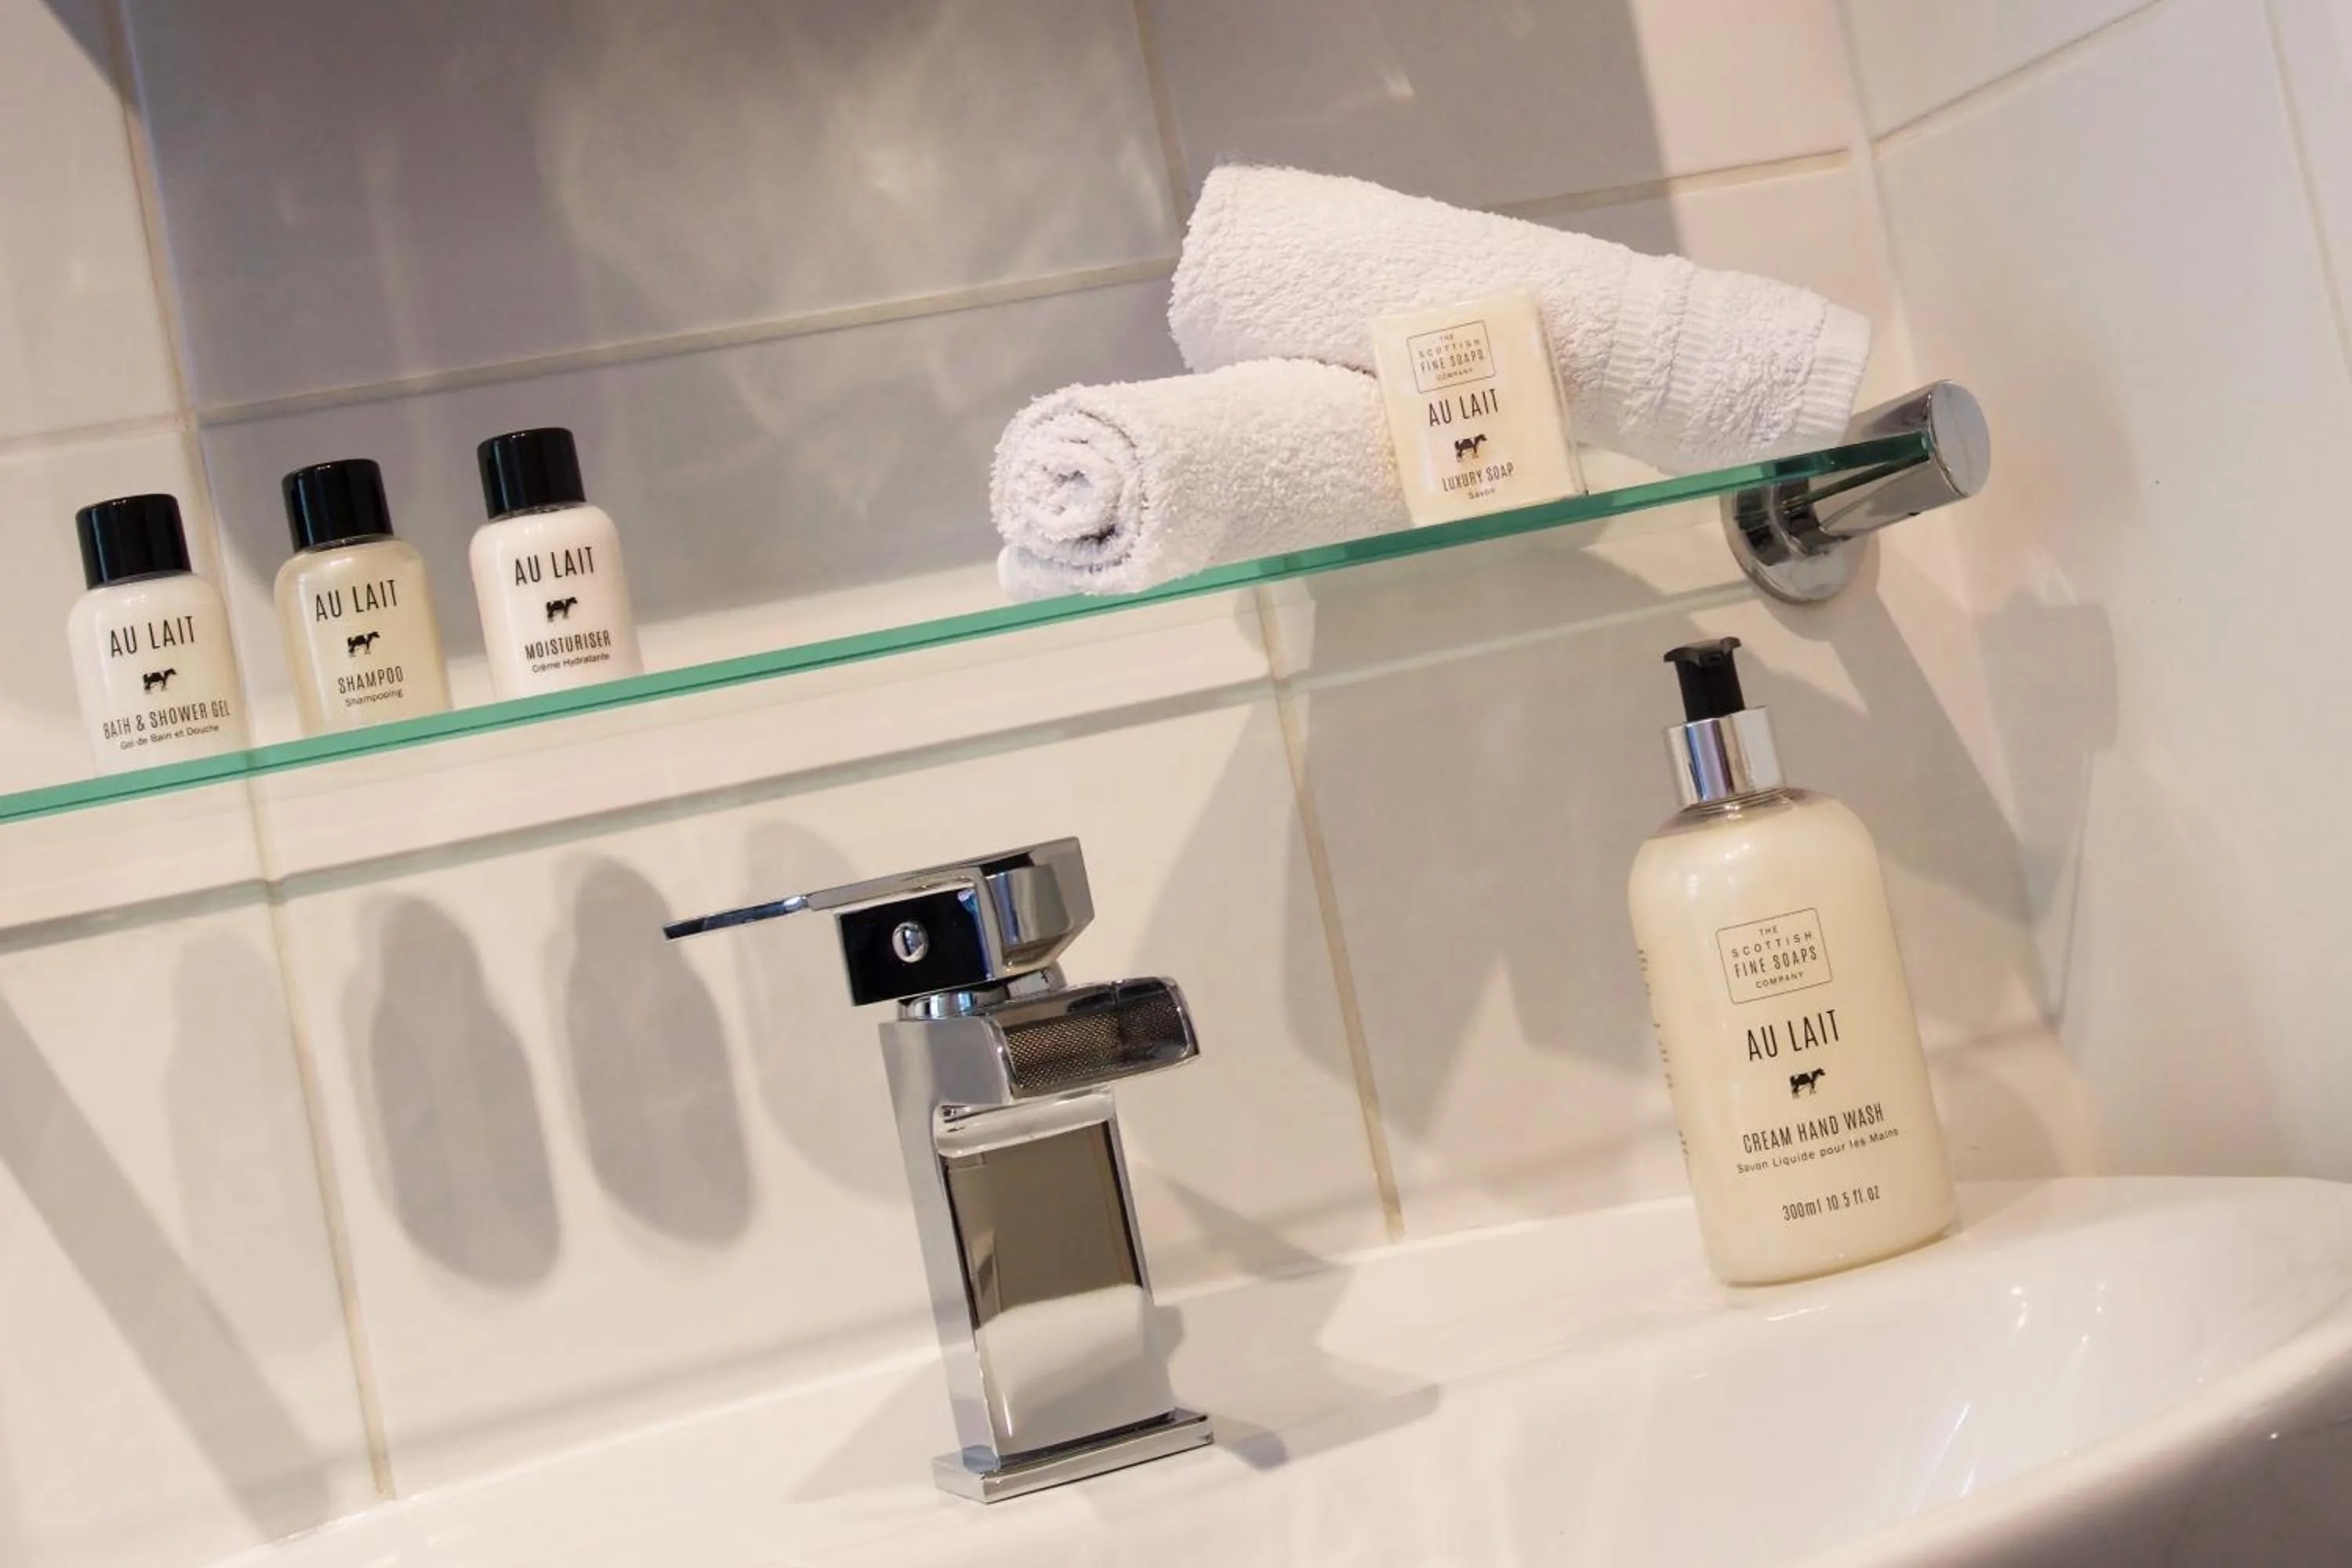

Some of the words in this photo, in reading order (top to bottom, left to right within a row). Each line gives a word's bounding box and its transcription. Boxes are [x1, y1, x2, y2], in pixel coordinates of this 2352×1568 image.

[1419, 339, 1481, 358] SCOTTISH
[1420, 356, 1445, 373] FINE
[1450, 349, 1485, 367] SOAPS
[1436, 368, 1473, 381] COMPANY
[1428, 399, 1451, 426] AU
[1459, 389, 1499, 419] LAIT
[1442, 471, 1483, 492] LUXURY
[1486, 463, 1514, 481] SOAP
[515, 554, 541, 586] AU
[551, 546, 593, 578] LAIT
[315, 590, 342, 622] AU
[352, 579, 397, 613] LAIT
[111, 626, 137, 657] AU
[148, 616, 194, 649] LAIT
[524, 630, 612, 660] MOISTURISER
[563, 653, 609, 666] Hydratante
[338, 666, 404, 694] SHAMPOO
[345, 689, 403, 706] Shampooing
[103, 717, 131, 739] BATH
[136, 715, 145, 731] &
[150, 702, 208, 728] SHOWER
[211, 700, 230, 717] GEL
[121, 740, 134, 750] Gel
[151, 733, 172, 742] Bain
[186, 724, 219, 736] Douche
[1731, 931, 1813, 958] SCOTTISH
[1759, 926, 1778, 935] THE
[1734, 958, 1766, 978] FINE
[1773, 946, 1817, 970] SOAPS
[1755, 971, 1804, 989] COMPANY
[1748, 1025, 1778, 1062] AU
[1788, 1010, 1838, 1051] LAIT
[1743, 1126, 1793, 1153] CREAM
[1797, 1115, 1839, 1142] HAND
[1842, 1102, 1884, 1131] WASH
[1737, 1162, 1769, 1174] Savon
[1773, 1152, 1815, 1167] Liquide
[1820, 1144, 1846, 1157] pour
[1849, 1139, 1866, 1149] les
[1870, 1128, 1899, 1143] Mains
[1782, 1199, 1822, 1221] 300ml
